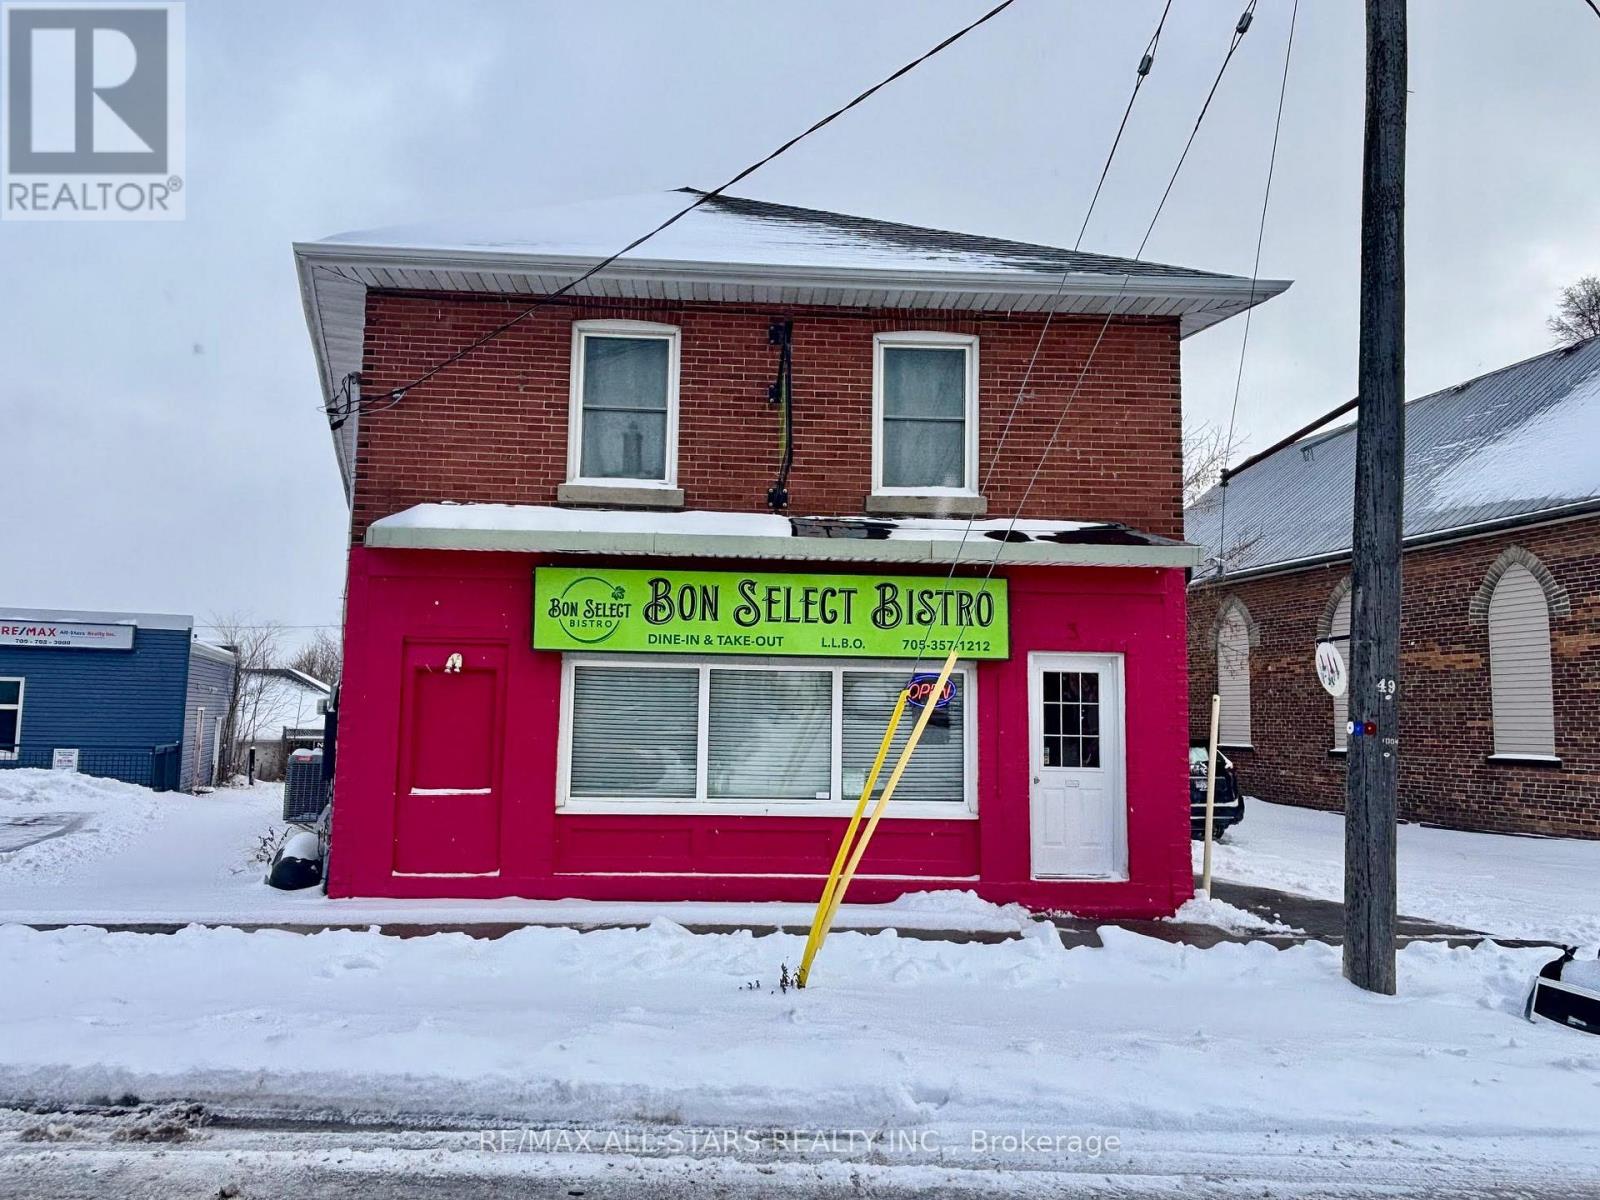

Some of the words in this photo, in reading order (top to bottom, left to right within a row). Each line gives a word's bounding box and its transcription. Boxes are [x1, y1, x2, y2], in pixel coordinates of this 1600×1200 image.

[569, 619, 613, 629] BISTRO
[1, 626, 57, 637] RE/MAX
[648, 633, 700, 645] DINE-IN
[703, 634, 714, 646] &
[717, 635, 785, 647] TAKE-OUT
[821, 637, 866, 649] L.L.B.O.
[902, 639, 991, 652] 705-357-1212
[908, 683, 952, 699] OPN
[1376, 678, 1396, 694] 49
